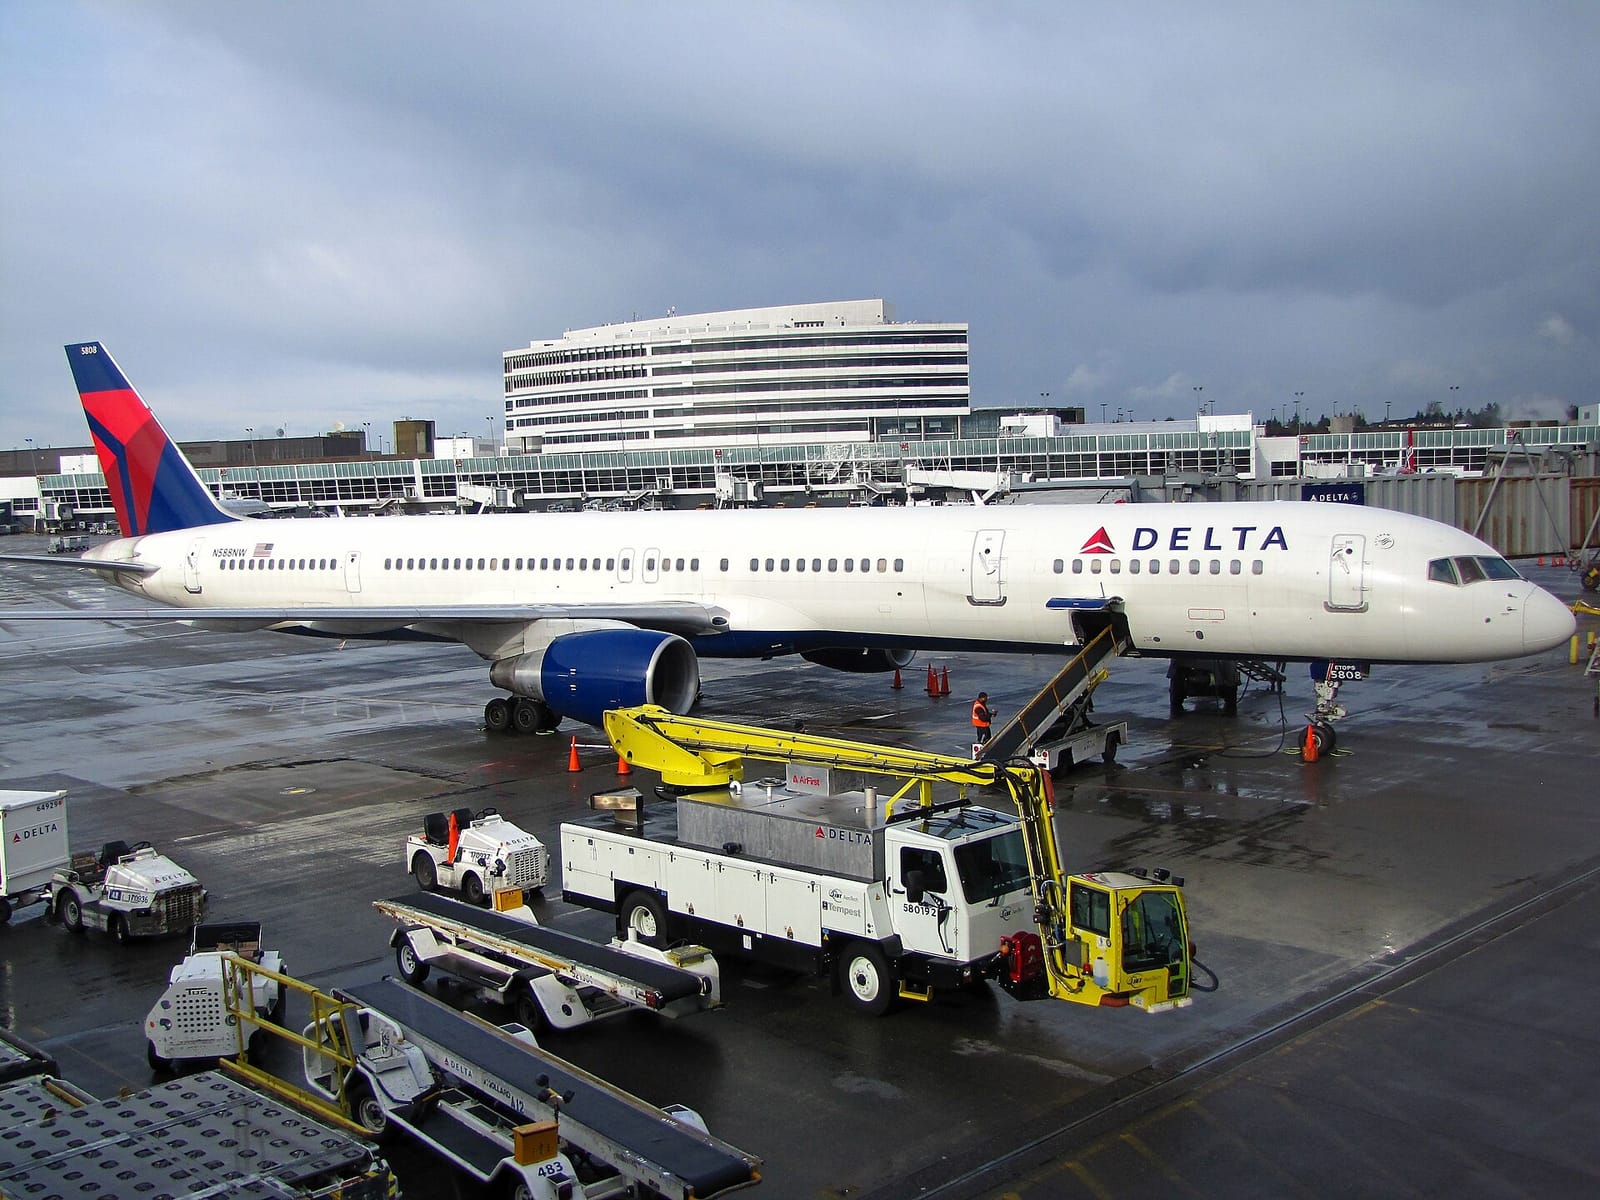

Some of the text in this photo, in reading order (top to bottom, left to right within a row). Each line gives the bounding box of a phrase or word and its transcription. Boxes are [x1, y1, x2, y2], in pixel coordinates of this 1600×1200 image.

[81, 345, 98, 356] 5808
[1319, 493, 1350, 502] DELTA
[1131, 526, 1289, 551] DELTA
[212, 548, 248, 558] N588NW
[1331, 670, 1362, 680] 5808
[799, 776, 820, 786] AirFirst
[23, 823, 58, 840] DELTA
[829, 829, 872, 845] DELTA
[511, 836, 535, 845] DELTA
[161, 872, 189, 882] DELTA
[829, 902, 861, 918] Tempest
[903, 903, 937, 917] 580192
[450, 1060, 473, 1079] DELTA
[537, 1161, 564, 1178] 483
